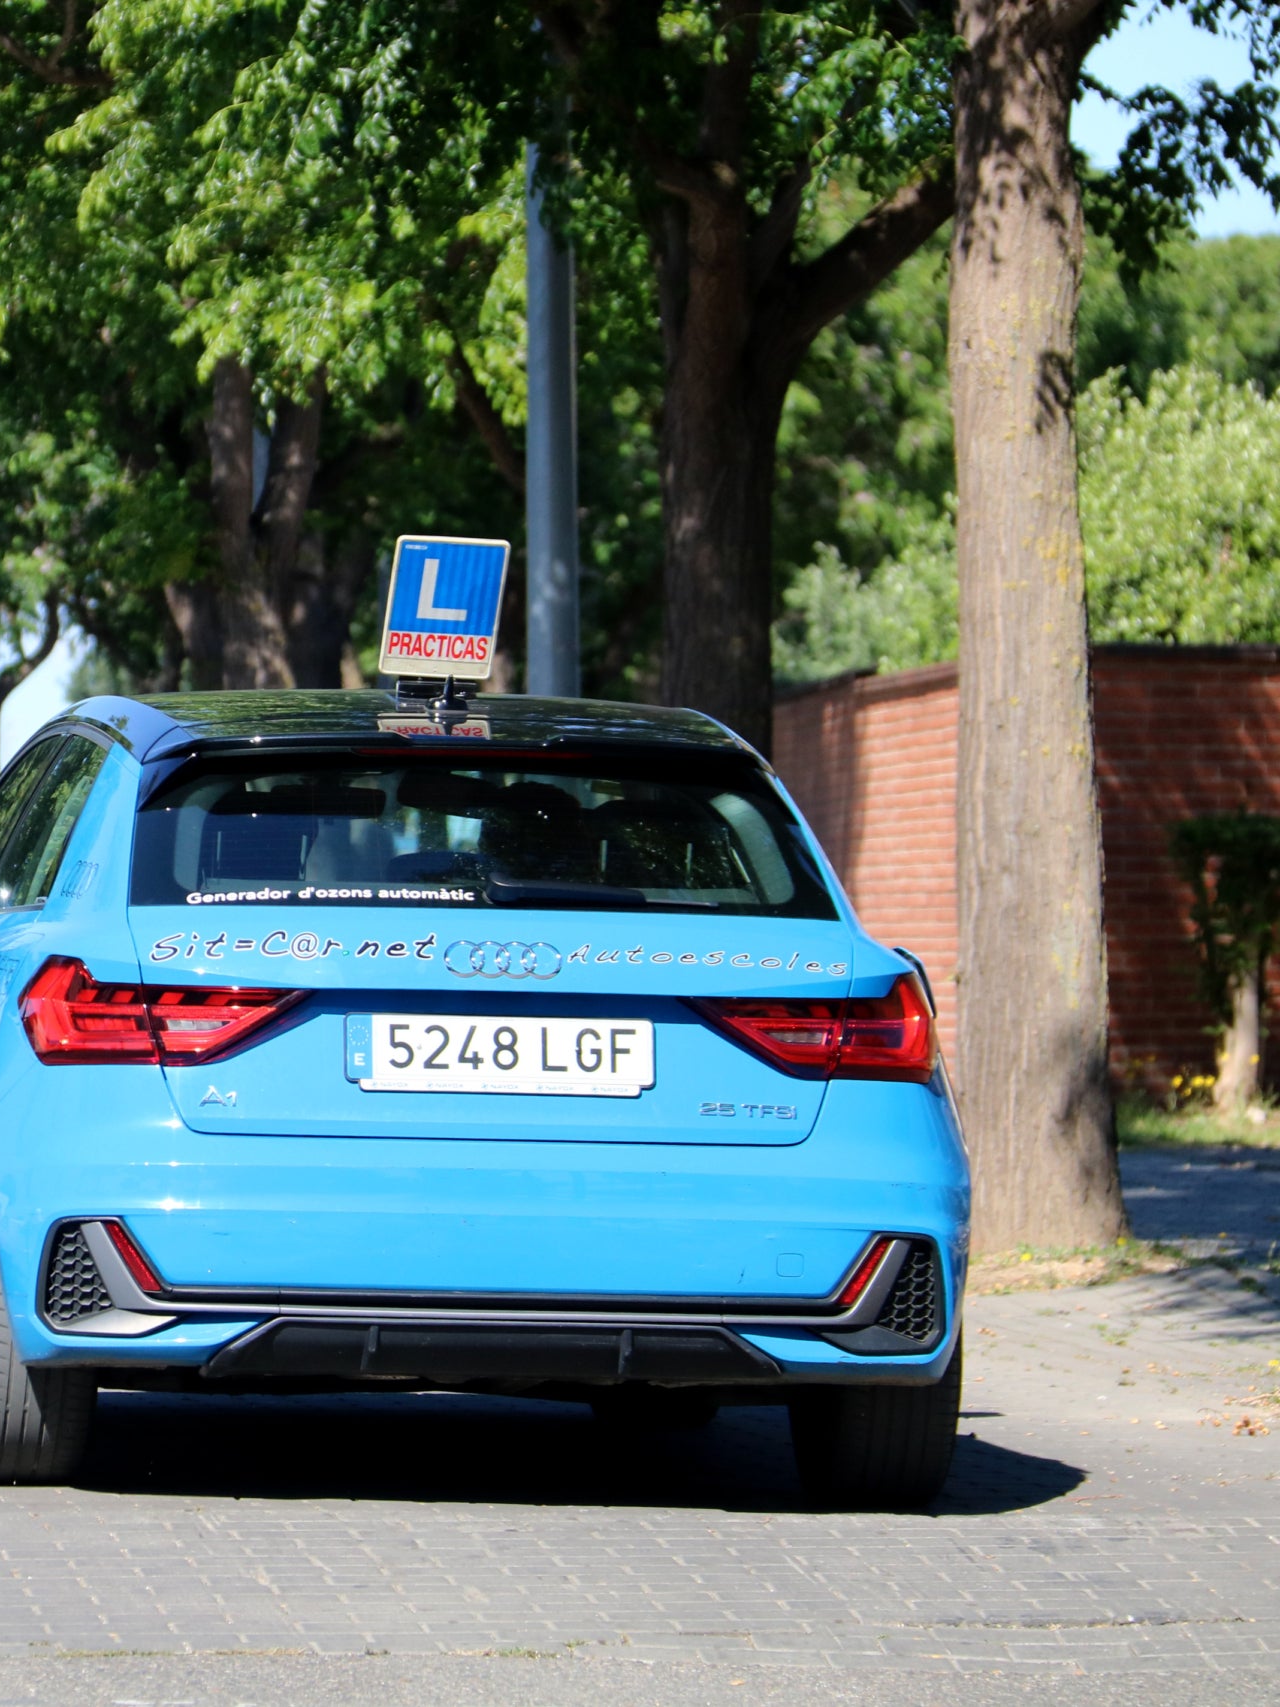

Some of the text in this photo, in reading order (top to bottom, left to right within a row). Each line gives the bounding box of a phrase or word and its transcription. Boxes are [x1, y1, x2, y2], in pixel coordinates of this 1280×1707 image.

[416, 558, 468, 621] L
[387, 632, 488, 660] PRACTICAS
[186, 886, 475, 904] Generador d'ozons automàtic
[567, 943, 848, 976] Autoescoles
[353, 1023, 636, 1073] E 5248 LGF
[199, 1084, 237, 1107] A1
[700, 1102, 736, 1117] 25
